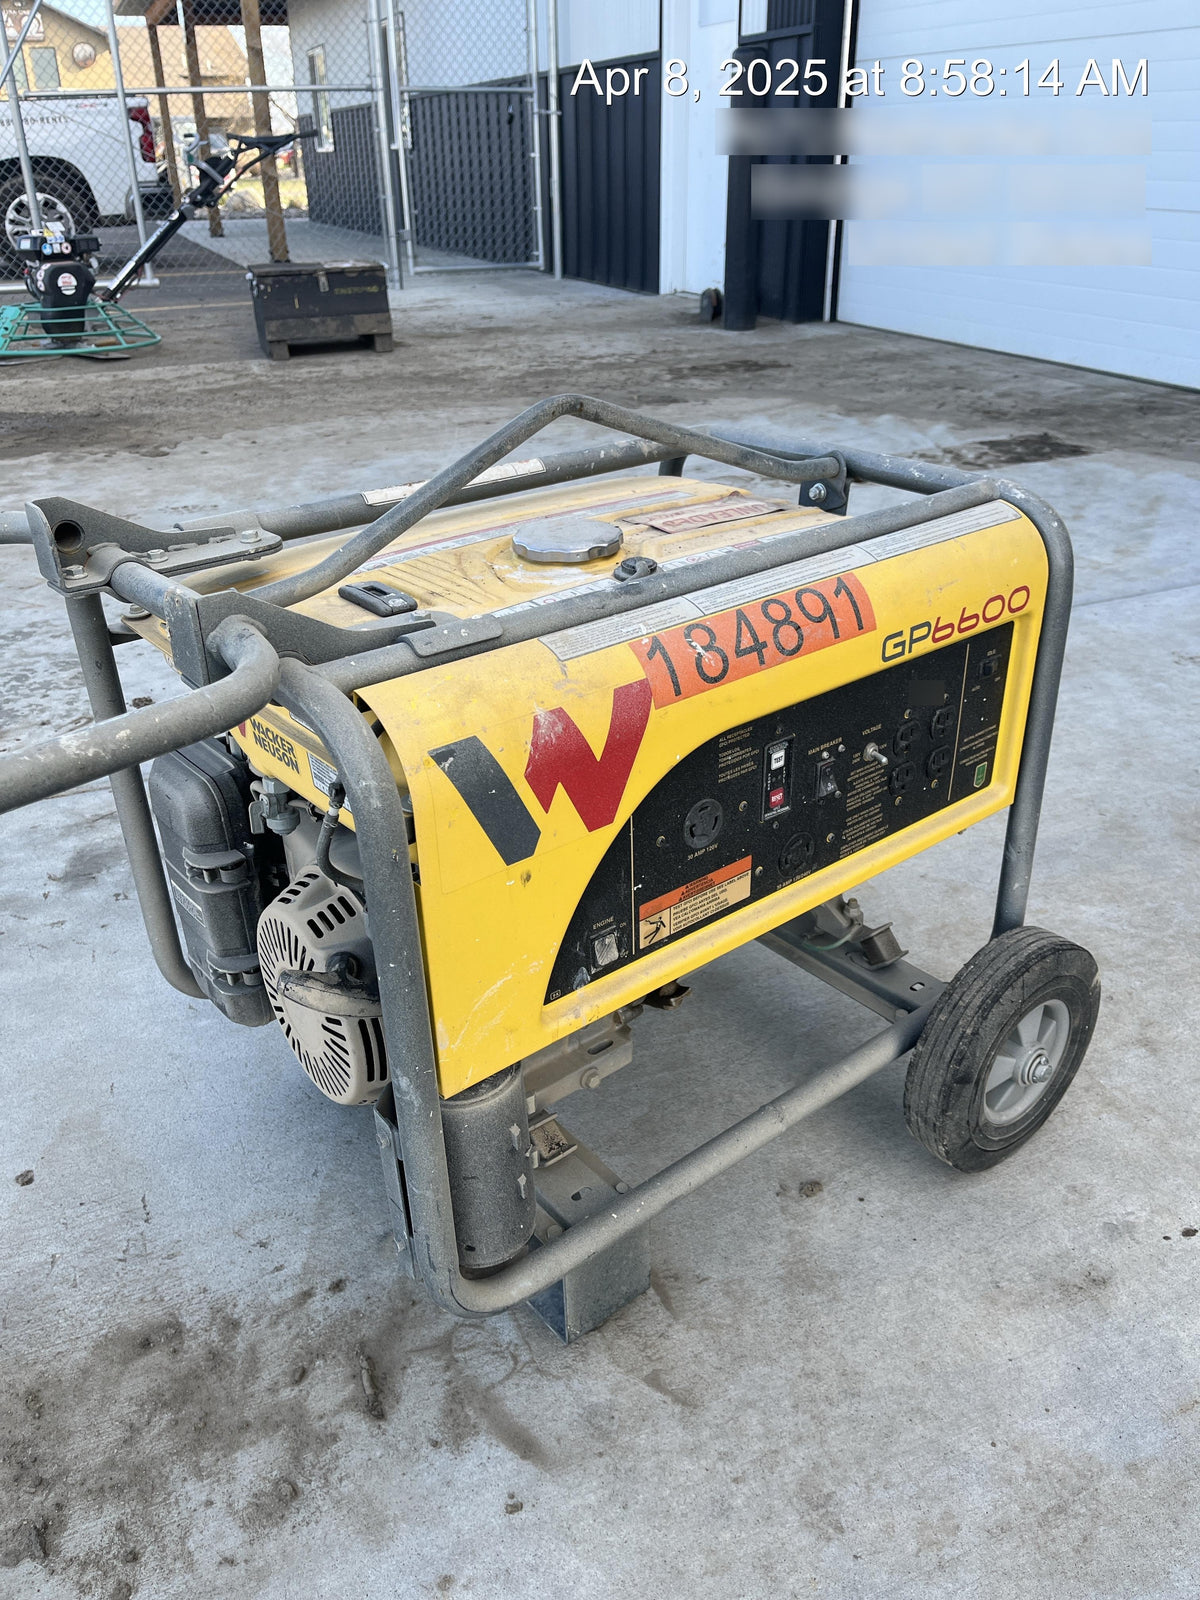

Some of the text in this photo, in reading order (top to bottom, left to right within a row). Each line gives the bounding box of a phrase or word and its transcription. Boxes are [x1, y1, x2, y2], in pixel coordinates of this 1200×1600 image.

[647, 576, 864, 697] 184891
[881, 585, 1031, 663] GP6600
[250, 718, 297, 759] WACKER
[820, 737, 843, 750] BREAKER
[862, 724, 882, 735] VOLTAGE
[253, 732, 300, 774] NEUSON
[593, 916, 614, 929] ENGINE
